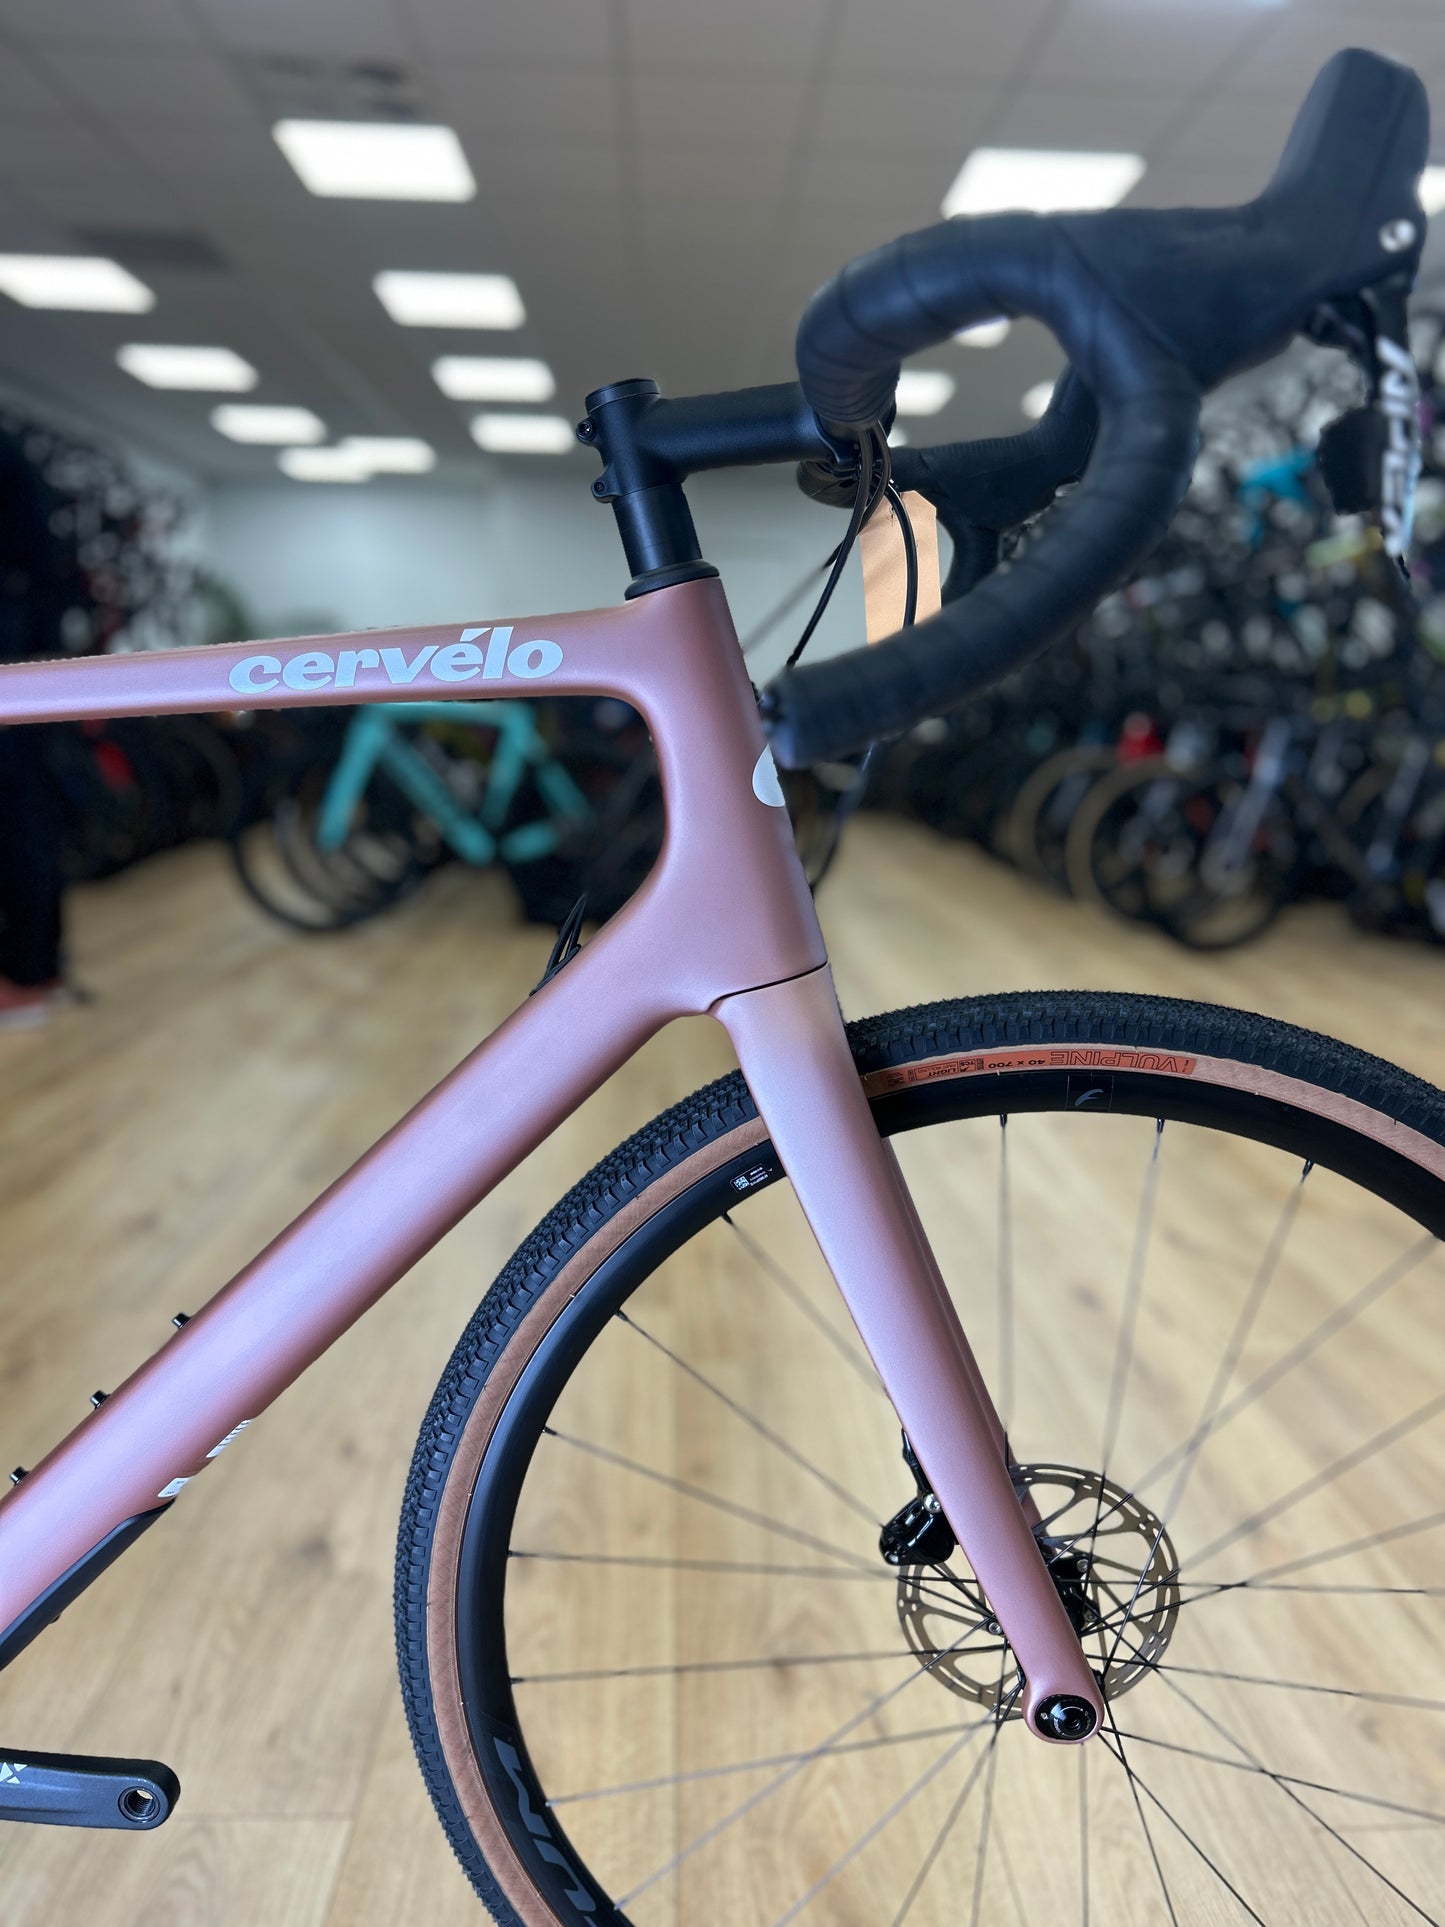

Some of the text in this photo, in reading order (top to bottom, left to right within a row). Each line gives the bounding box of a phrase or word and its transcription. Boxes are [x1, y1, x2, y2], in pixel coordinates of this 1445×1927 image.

[228, 626, 564, 694] cervélo
[988, 1061, 1014, 1069] 700
[1050, 1051, 1178, 1073] VULPINE
